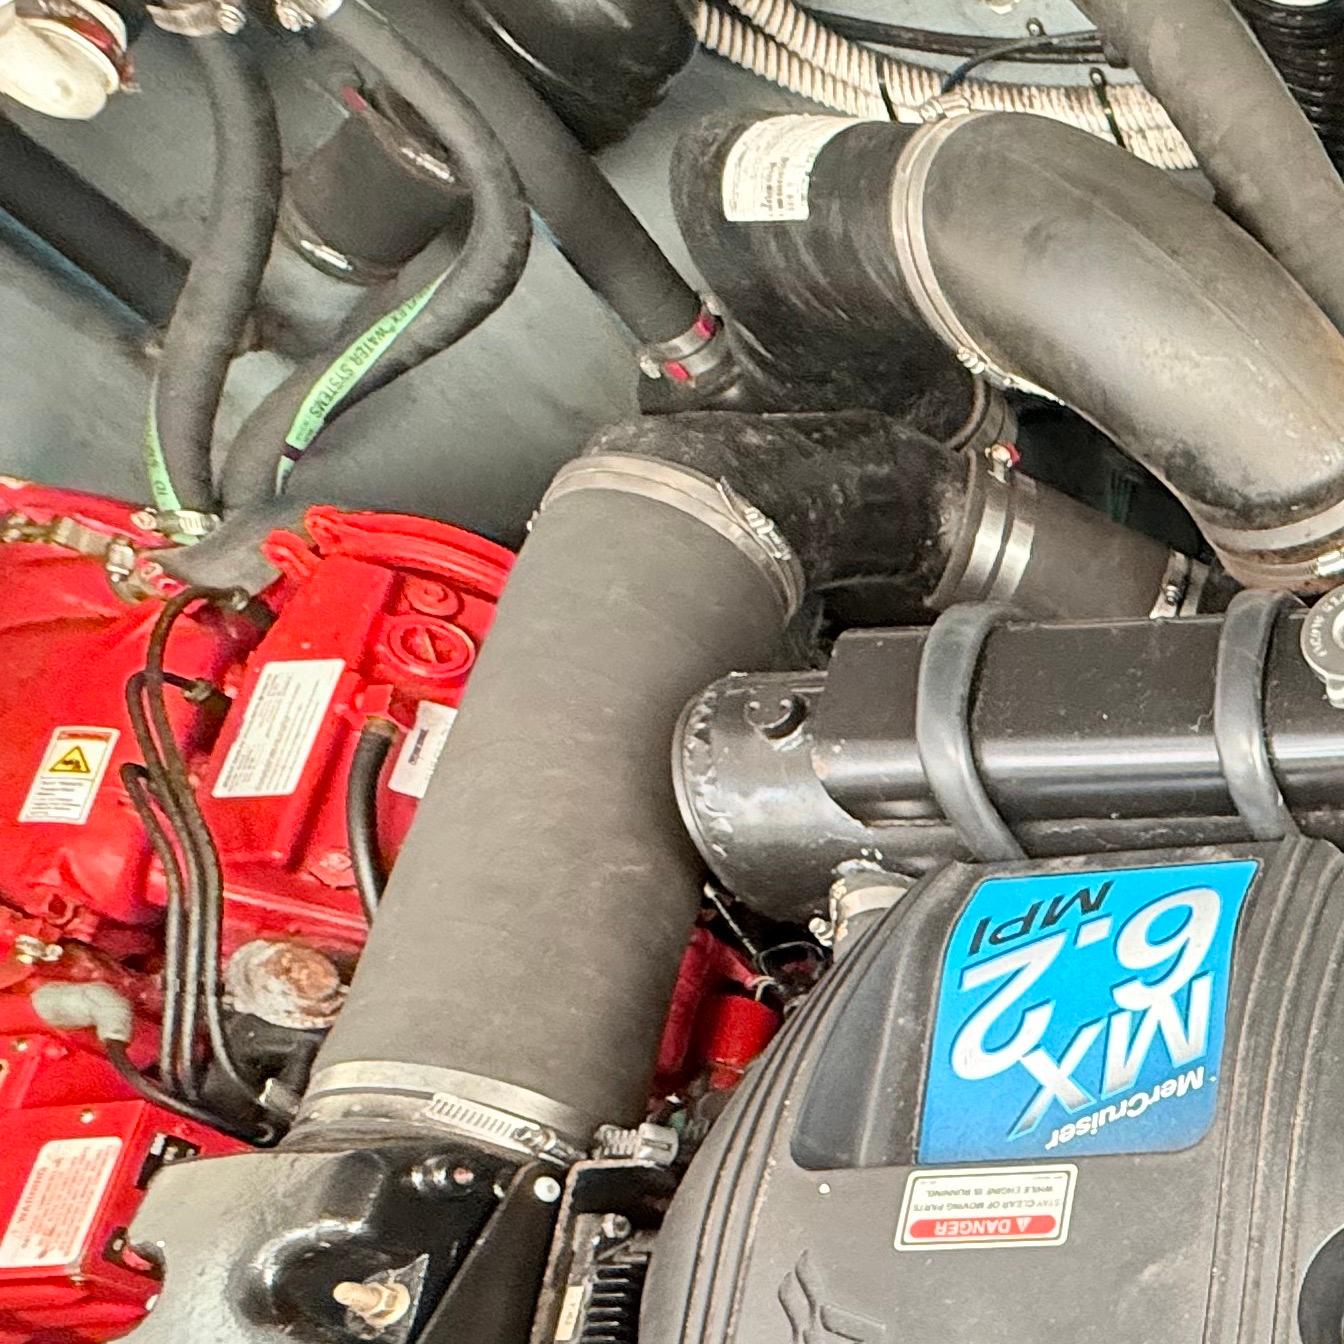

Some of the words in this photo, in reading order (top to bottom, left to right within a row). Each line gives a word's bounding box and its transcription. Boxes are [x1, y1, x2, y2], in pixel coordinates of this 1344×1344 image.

[352, 327, 387, 367] WATER
[309, 363, 355, 418] SYSTEMS
[968, 881, 1113, 956] MPI
[950, 887, 1222, 1080] 6.2
[1006, 970, 1215, 1141] MX
[1045, 1066, 1205, 1150] MerCruiser
[974, 1188, 984, 1196] IS
[986, 1187, 1022, 1196] ENGINE
[1024, 1186, 1053, 1194] WHILE
[913, 1203, 943, 1212] PARTS
[946, 1202, 985, 1211] MOVING
[986, 1201, 1000, 1210] OF
[1003, 1200, 1036, 1210] CLEAR
[1034, 1199, 1061, 1209] STAY
[934, 1217, 1012, 1236] DANGER
